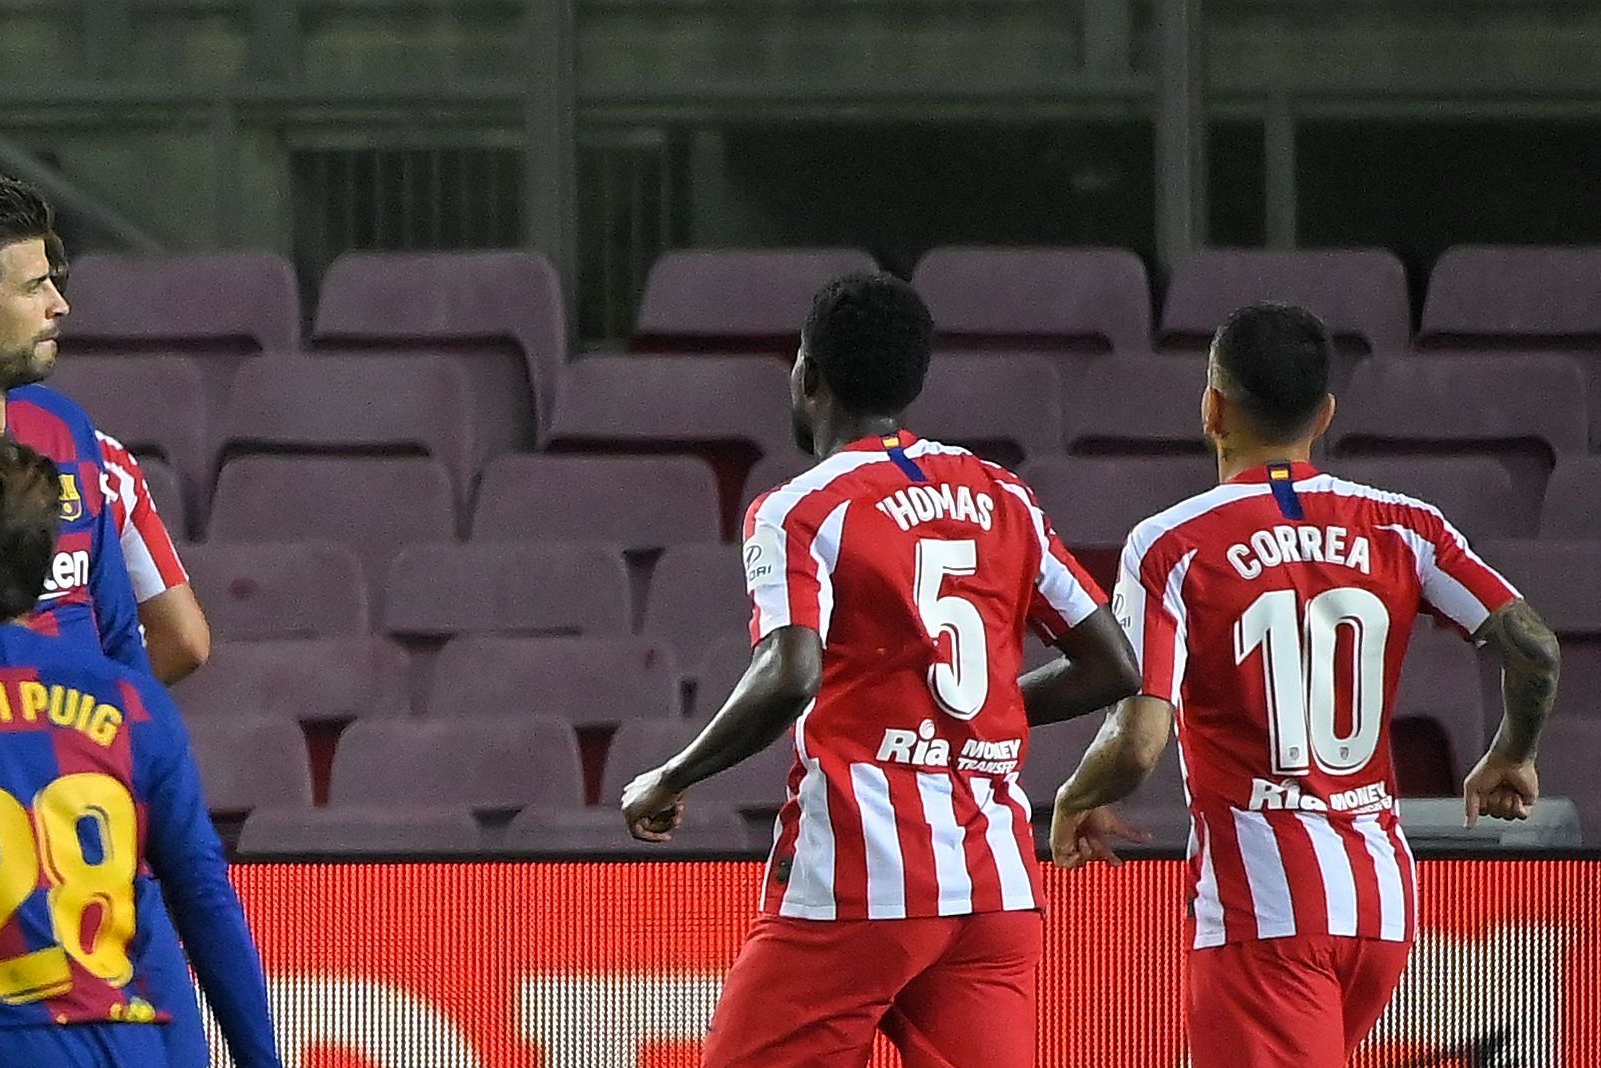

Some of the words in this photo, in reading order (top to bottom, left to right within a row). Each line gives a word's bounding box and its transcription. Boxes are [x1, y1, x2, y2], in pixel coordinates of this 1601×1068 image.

[875, 483, 994, 531] THOMAS
[1226, 525, 1371, 580] CORREA
[913, 538, 989, 721] 5
[1233, 587, 1390, 776] 10
[18, 681, 123, 747] PUIG
[875, 719, 950, 767] Ria
[1329, 780, 1388, 812] MONEY
